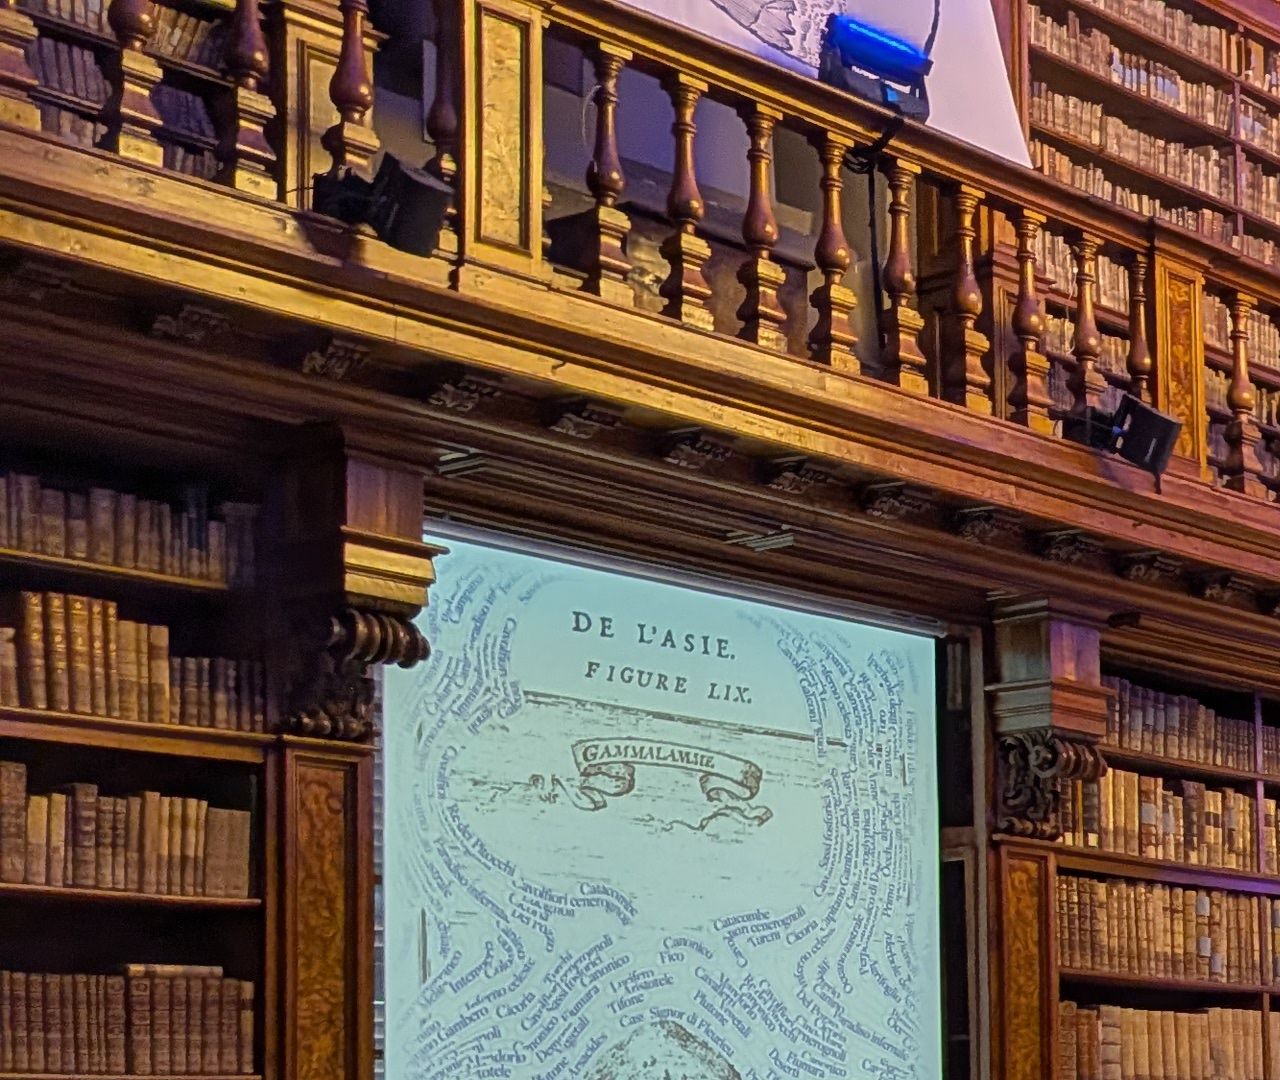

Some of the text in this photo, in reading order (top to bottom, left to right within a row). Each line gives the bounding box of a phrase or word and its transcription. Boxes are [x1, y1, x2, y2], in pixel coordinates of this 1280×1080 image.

[572, 611, 736, 660] DE L'ASIE.
[585, 661, 752, 704] FIGURE LIX.
